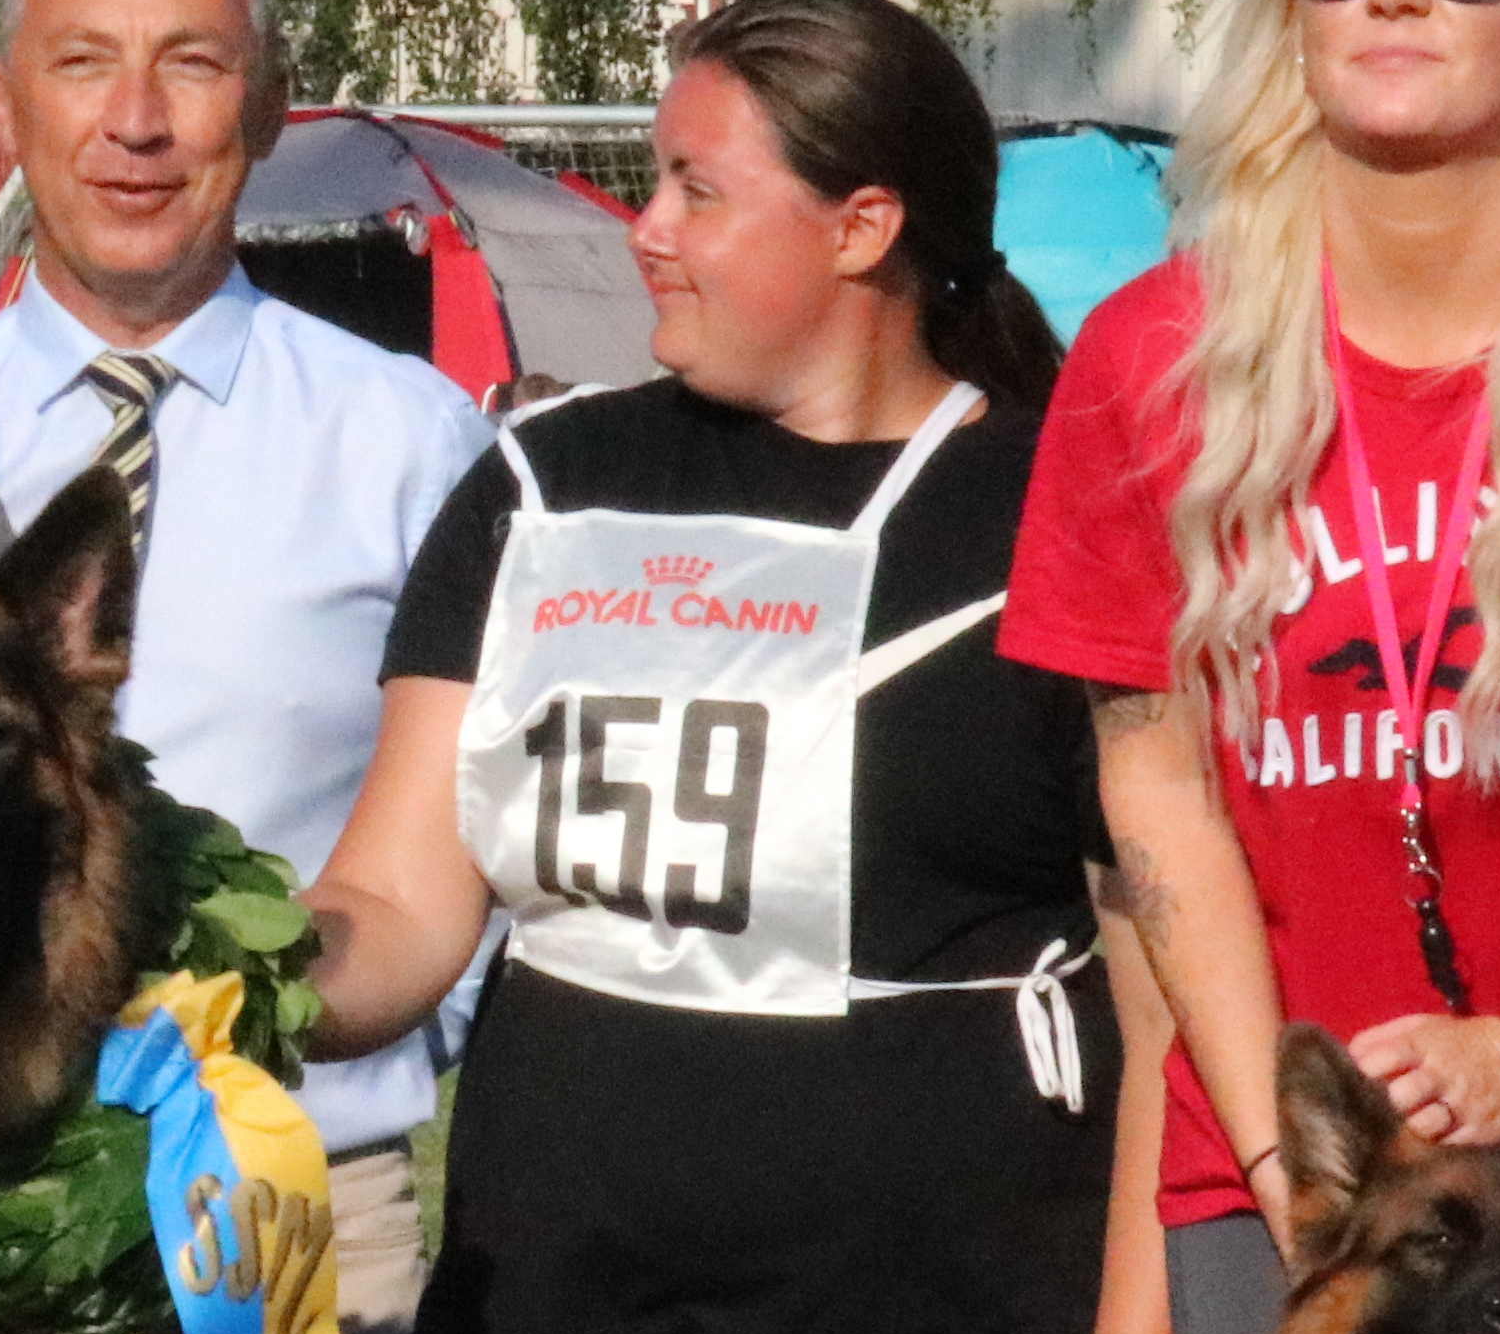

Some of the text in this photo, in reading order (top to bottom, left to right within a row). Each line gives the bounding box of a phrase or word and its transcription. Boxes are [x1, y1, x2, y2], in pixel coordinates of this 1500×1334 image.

[533, 589, 819, 636] ROYAL CANIN
[524, 694, 770, 935] 159
